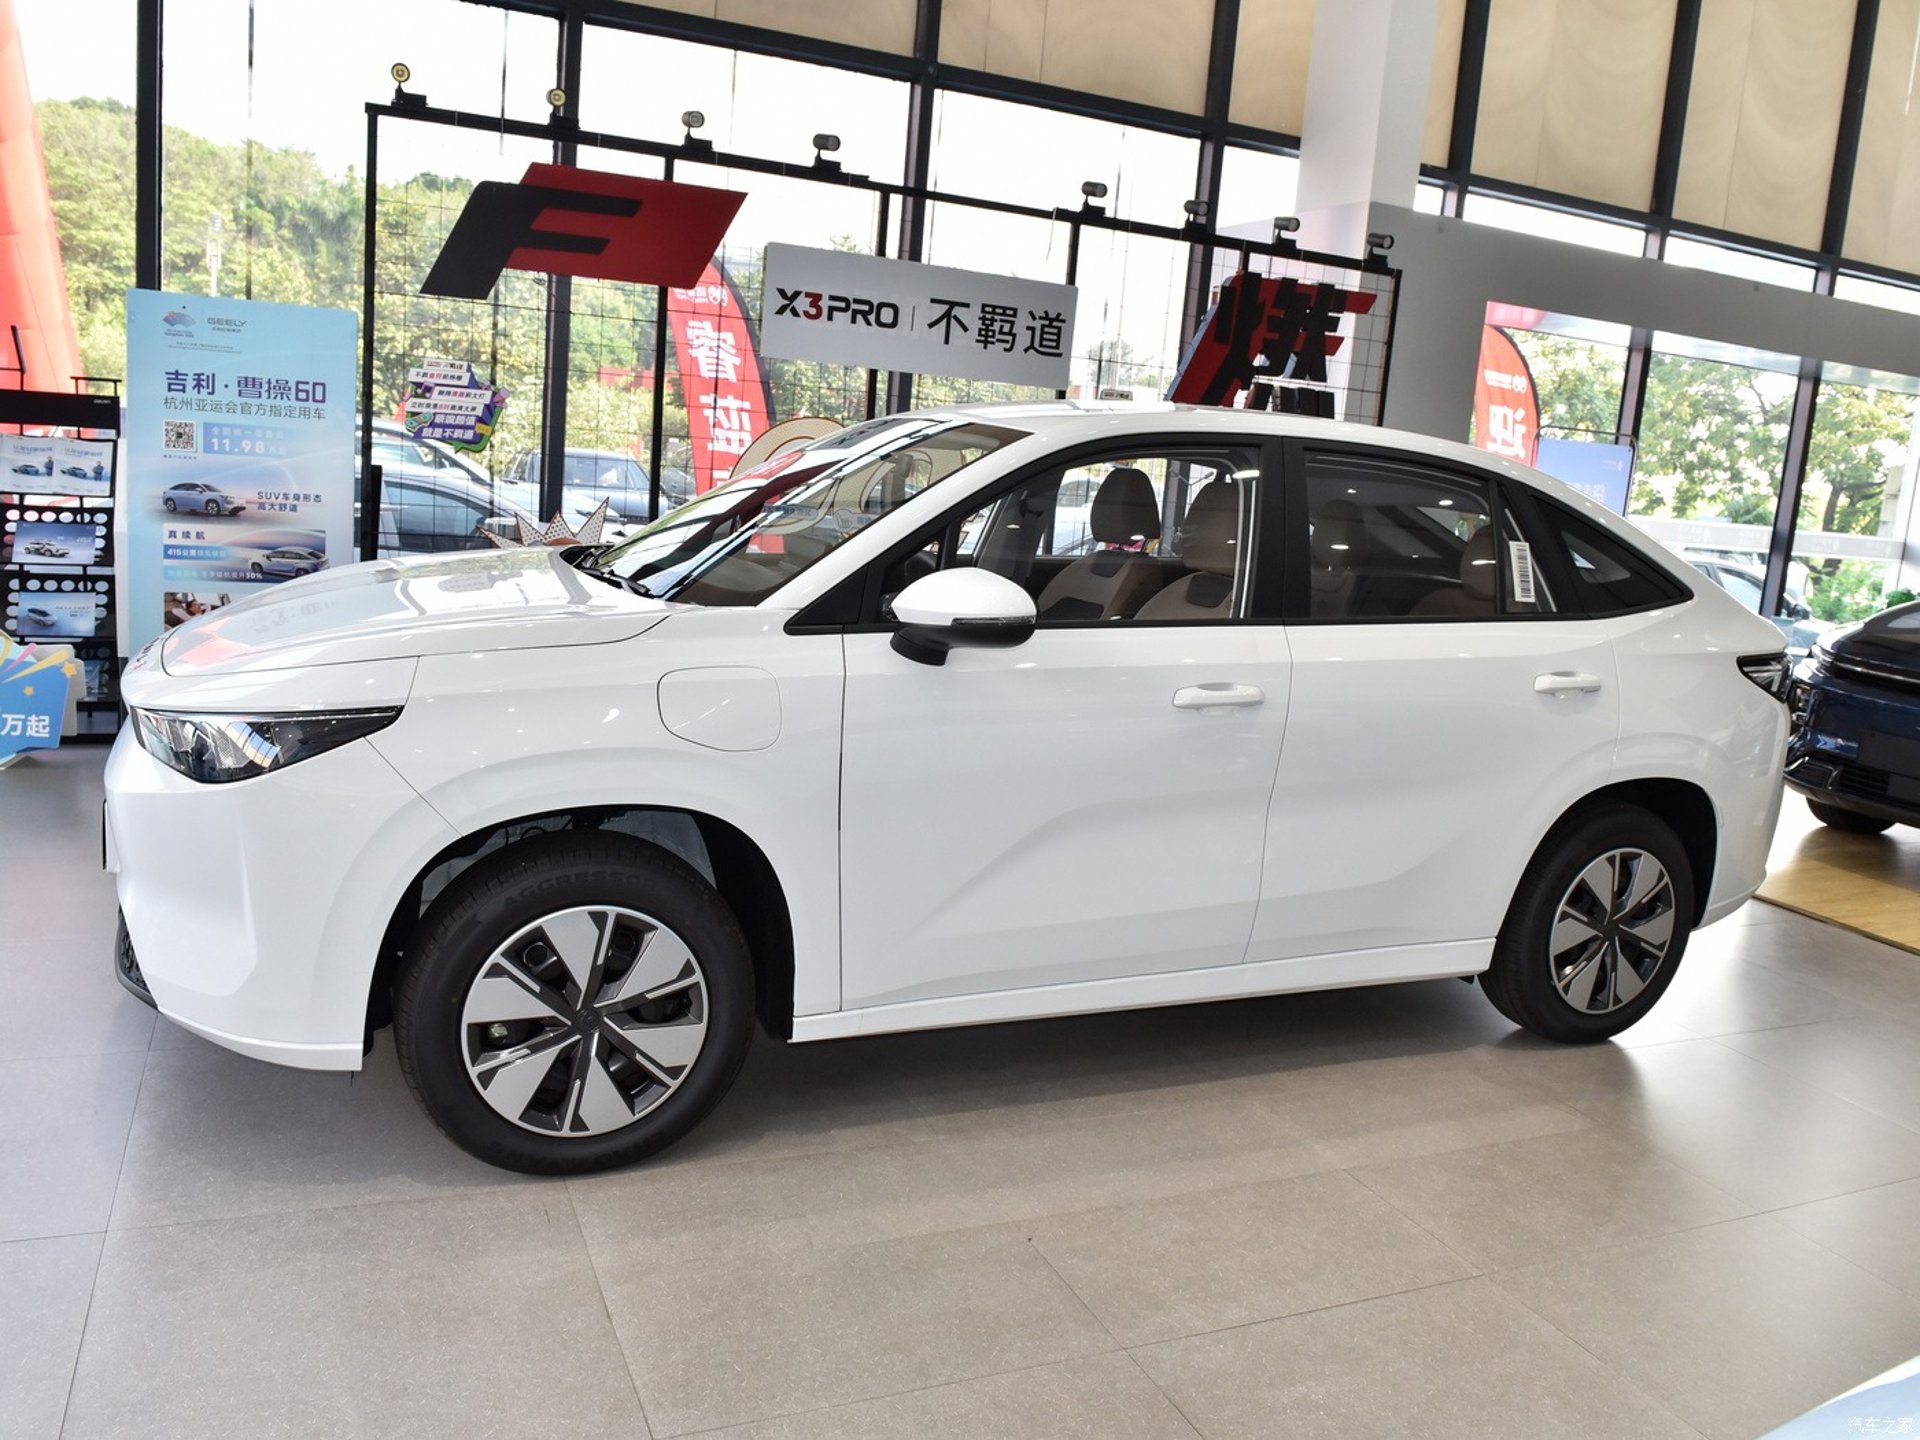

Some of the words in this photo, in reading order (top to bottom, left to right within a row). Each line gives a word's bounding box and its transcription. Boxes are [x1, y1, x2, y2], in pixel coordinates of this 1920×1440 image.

[207, 317, 247, 327] GEELY
[774, 287, 900, 329] X3PRO
[927, 297, 1067, 359] 不羁道
[163, 396, 326, 420] 杭州亚运会官方指定用车
[257, 491, 322, 503] SUV车身形态
[257, 502, 298, 513] 高大舒适
[0, 714, 50, 738] 万起
